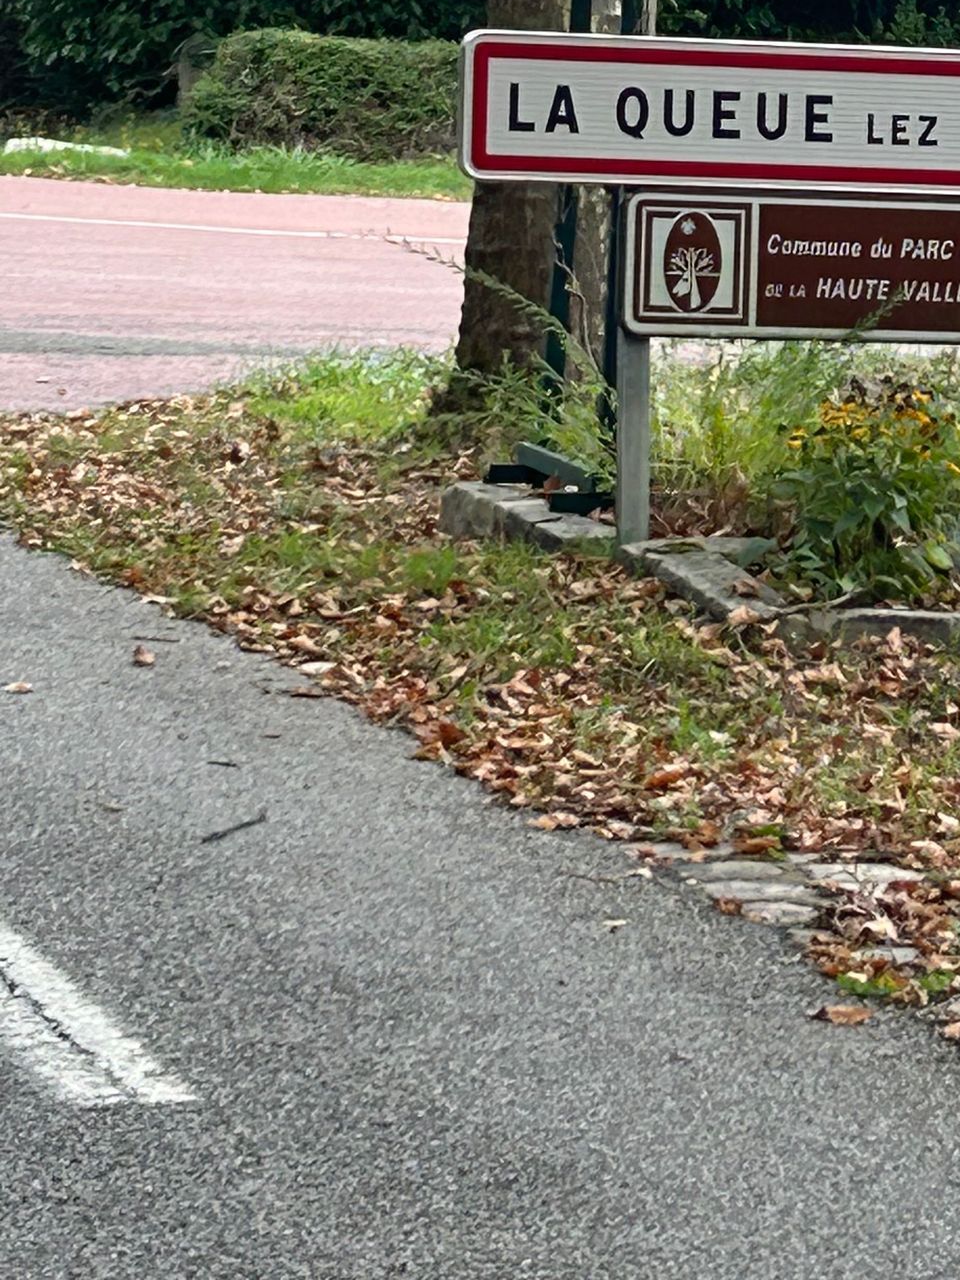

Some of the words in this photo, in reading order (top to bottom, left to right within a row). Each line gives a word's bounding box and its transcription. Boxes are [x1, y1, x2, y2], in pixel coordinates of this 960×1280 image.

[508, 82, 580, 135] LA
[615, 85, 834, 144] QUEUE
[866, 112, 938, 148] LEZ
[767, 233, 862, 258] Commune
[869, 237, 893, 259] du
[900, 237, 955, 260] PARC
[816, 277, 891, 300] HAUTE
